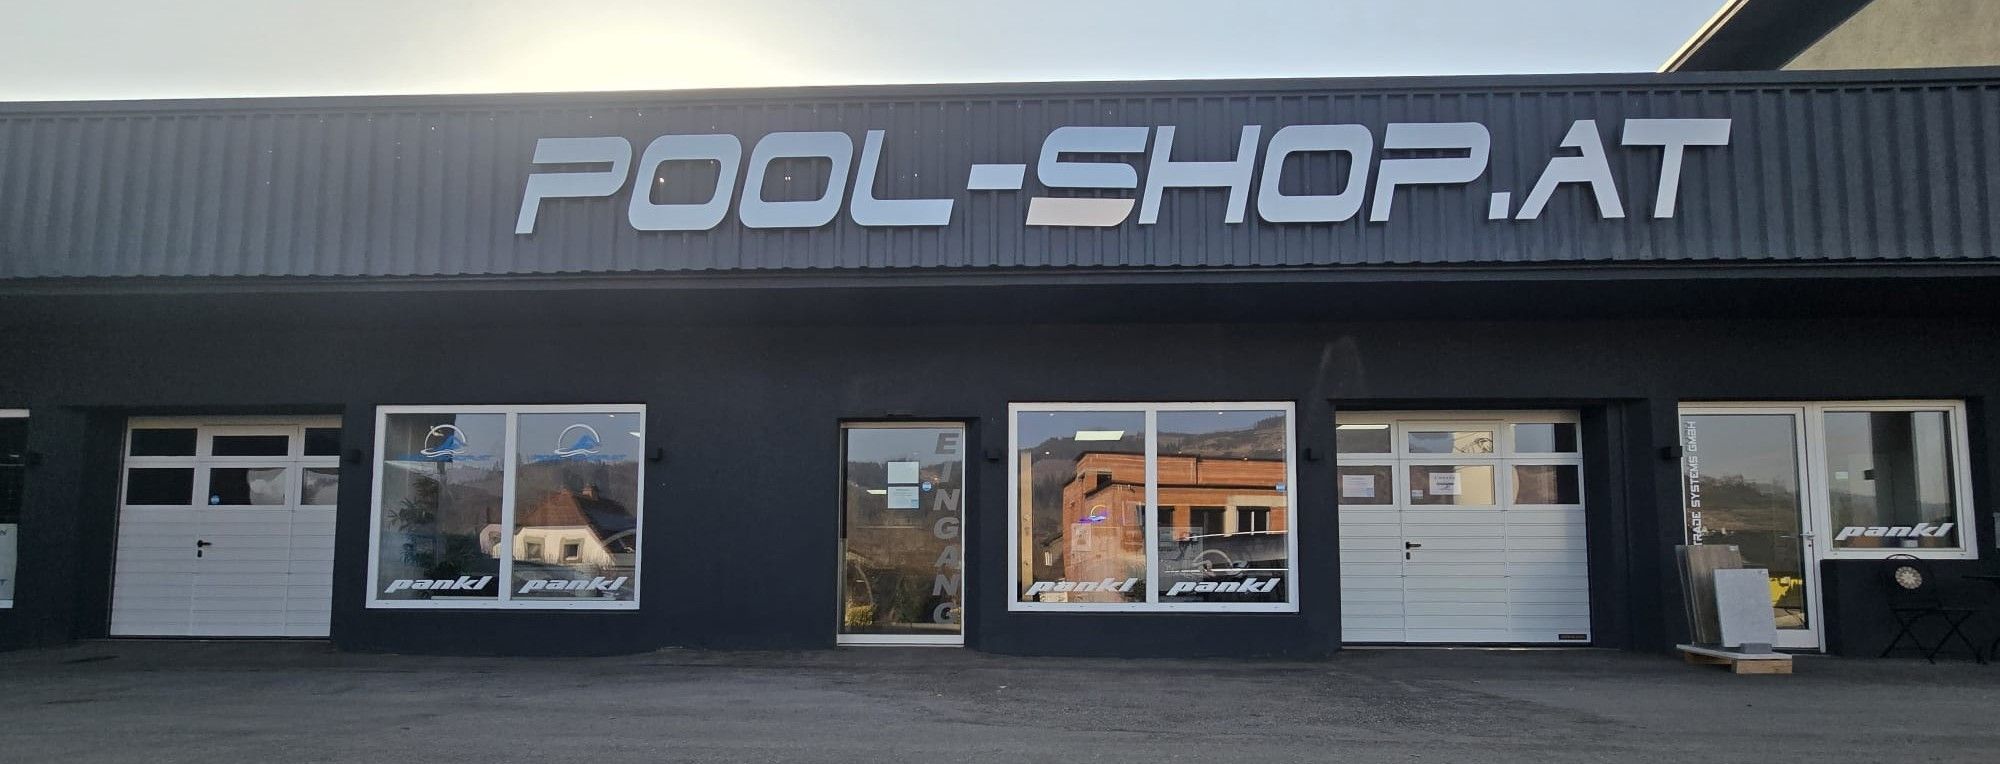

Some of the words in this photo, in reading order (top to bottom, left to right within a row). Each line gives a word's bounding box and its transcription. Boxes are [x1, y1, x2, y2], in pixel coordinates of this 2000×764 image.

[514, 118, 1732, 235] POOL-SHOP.AT
[1687, 420, 1698, 452] GMBH
[1688, 455, 1701, 508] SYSTEMS
[932, 432, 961, 625] EINGANG
[1834, 522, 1955, 541] pankl
[384, 575, 494, 593] pankl
[518, 576, 629, 593] pankl
[1024, 577, 1139, 596] pankl
[1166, 577, 1281, 596] pankl
